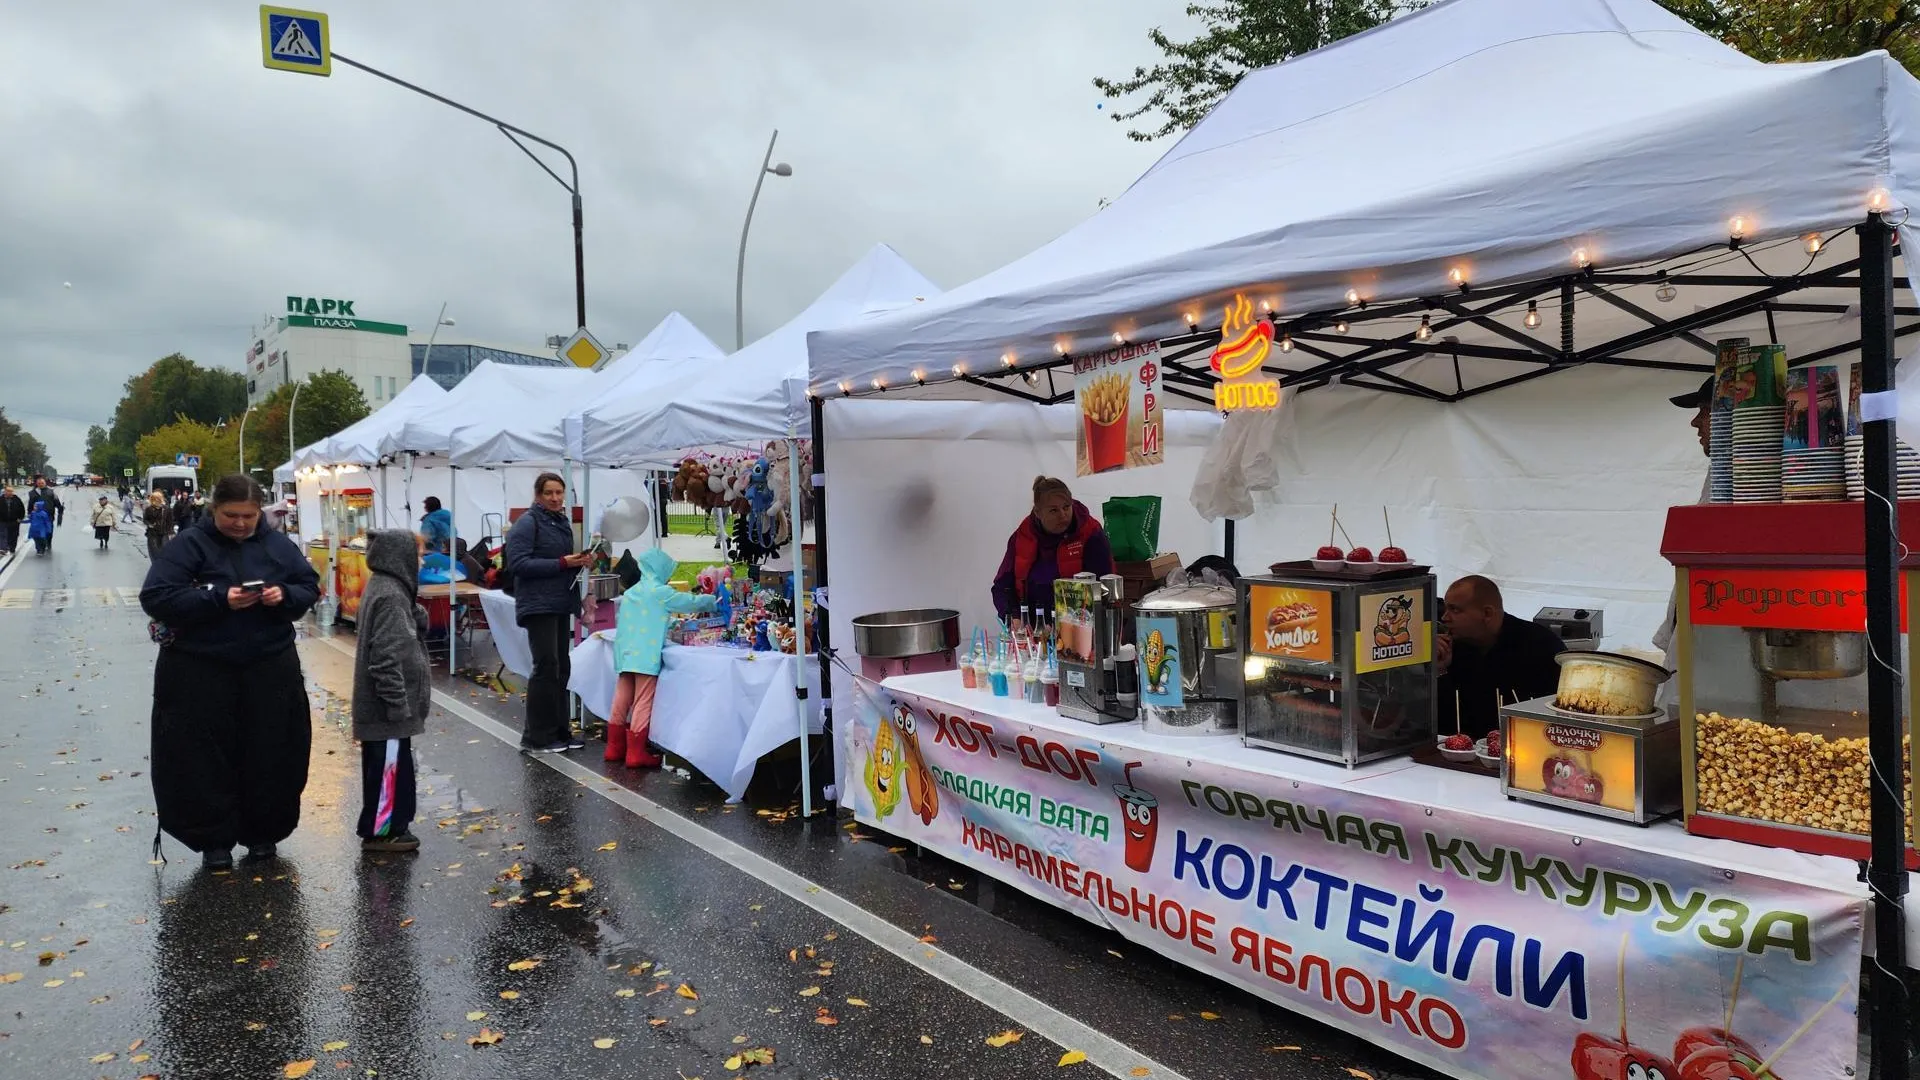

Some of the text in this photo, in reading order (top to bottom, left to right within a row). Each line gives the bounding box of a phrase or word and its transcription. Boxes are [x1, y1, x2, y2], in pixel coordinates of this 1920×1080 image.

[287, 296, 356, 316] ПАРК
[313, 318, 357, 329] ПЛАЗА
[1073, 340, 1159, 375] КАРТОШКА
[1139, 360, 1159, 456] ФРИ
[1694, 578, 1867, 614] Popcor
[1373, 643, 1413, 660] HOTDOG
[926, 708, 1101, 787] ХОТ-ДОГ
[1547, 725, 1600, 741] ЯБЛОЧКИ
[931, 765, 1110, 842] СЛАДКАЯ ВАТА
[1181, 779, 1811, 962] ГОРЯЧАЯ КУКУРУЗА
[961, 816, 1467, 1049] КАРАМЕЛЬНОЕ ЯБЛОКО
[1173, 829, 1588, 1020] КОКТЕЙЛИ
